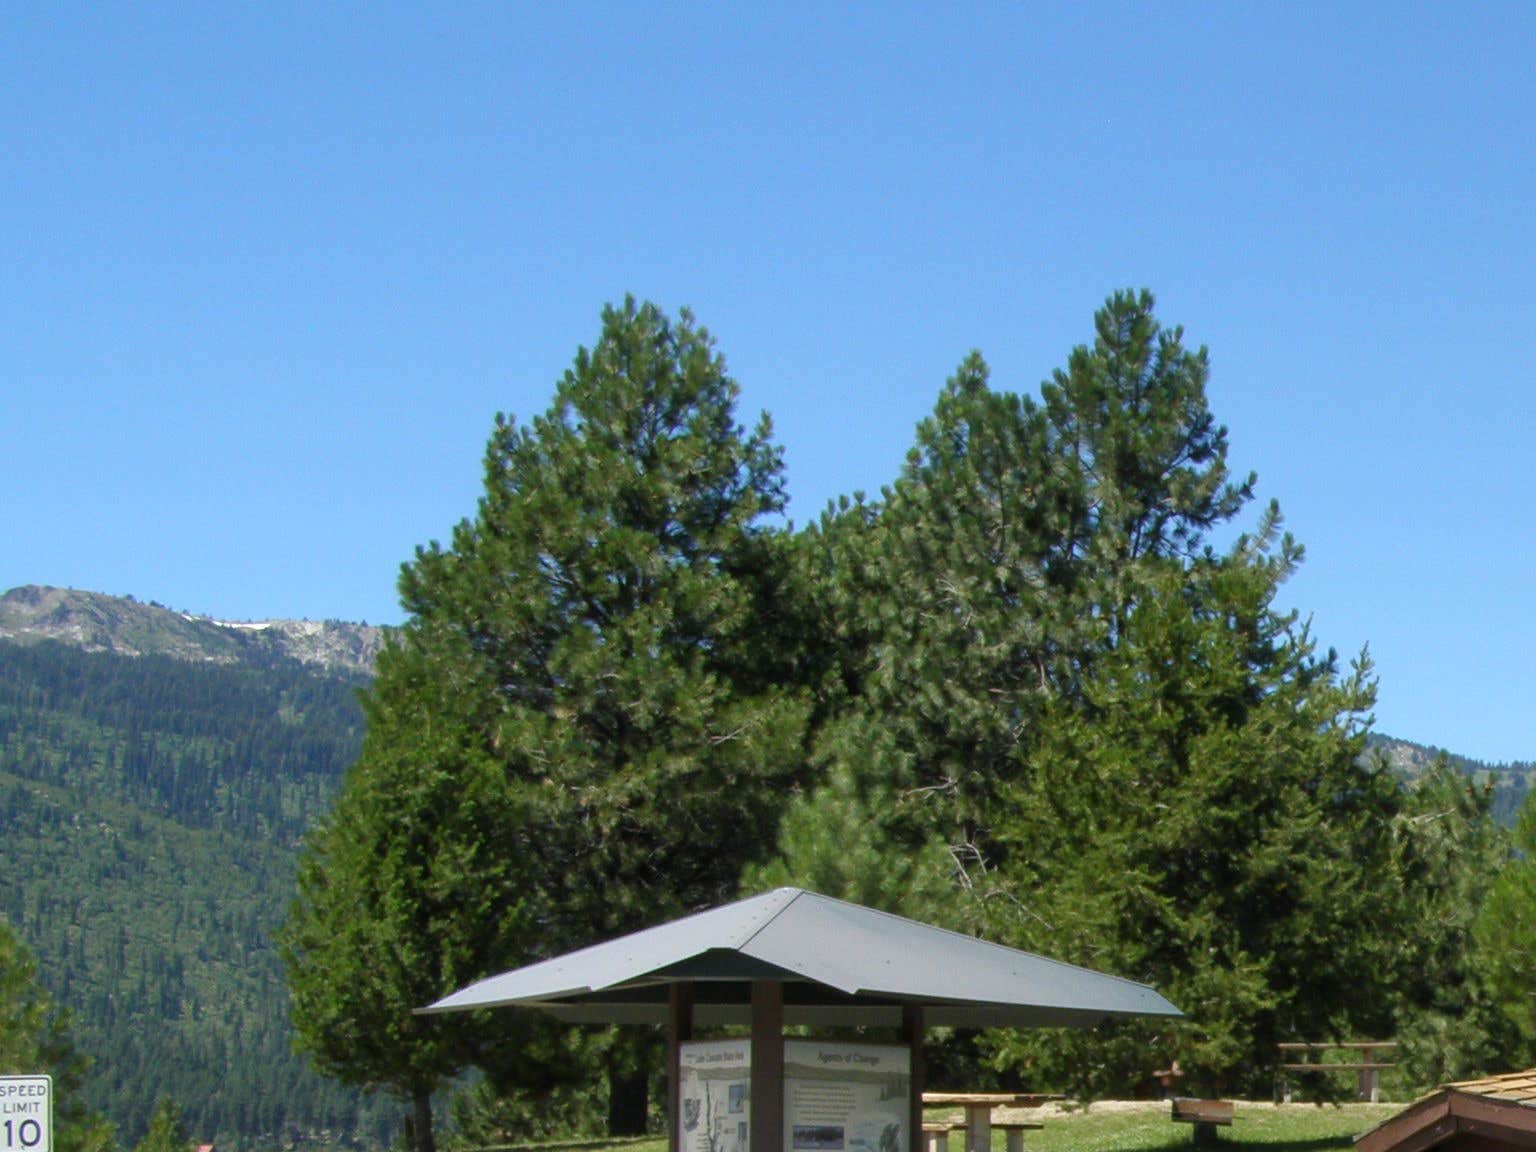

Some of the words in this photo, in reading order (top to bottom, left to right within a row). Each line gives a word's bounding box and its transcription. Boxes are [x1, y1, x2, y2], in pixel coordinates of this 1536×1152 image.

[0, 1085, 46, 1097] SPEED
[3, 1102, 41, 1114] LIMIT
[4, 1119, 42, 1148] 10
